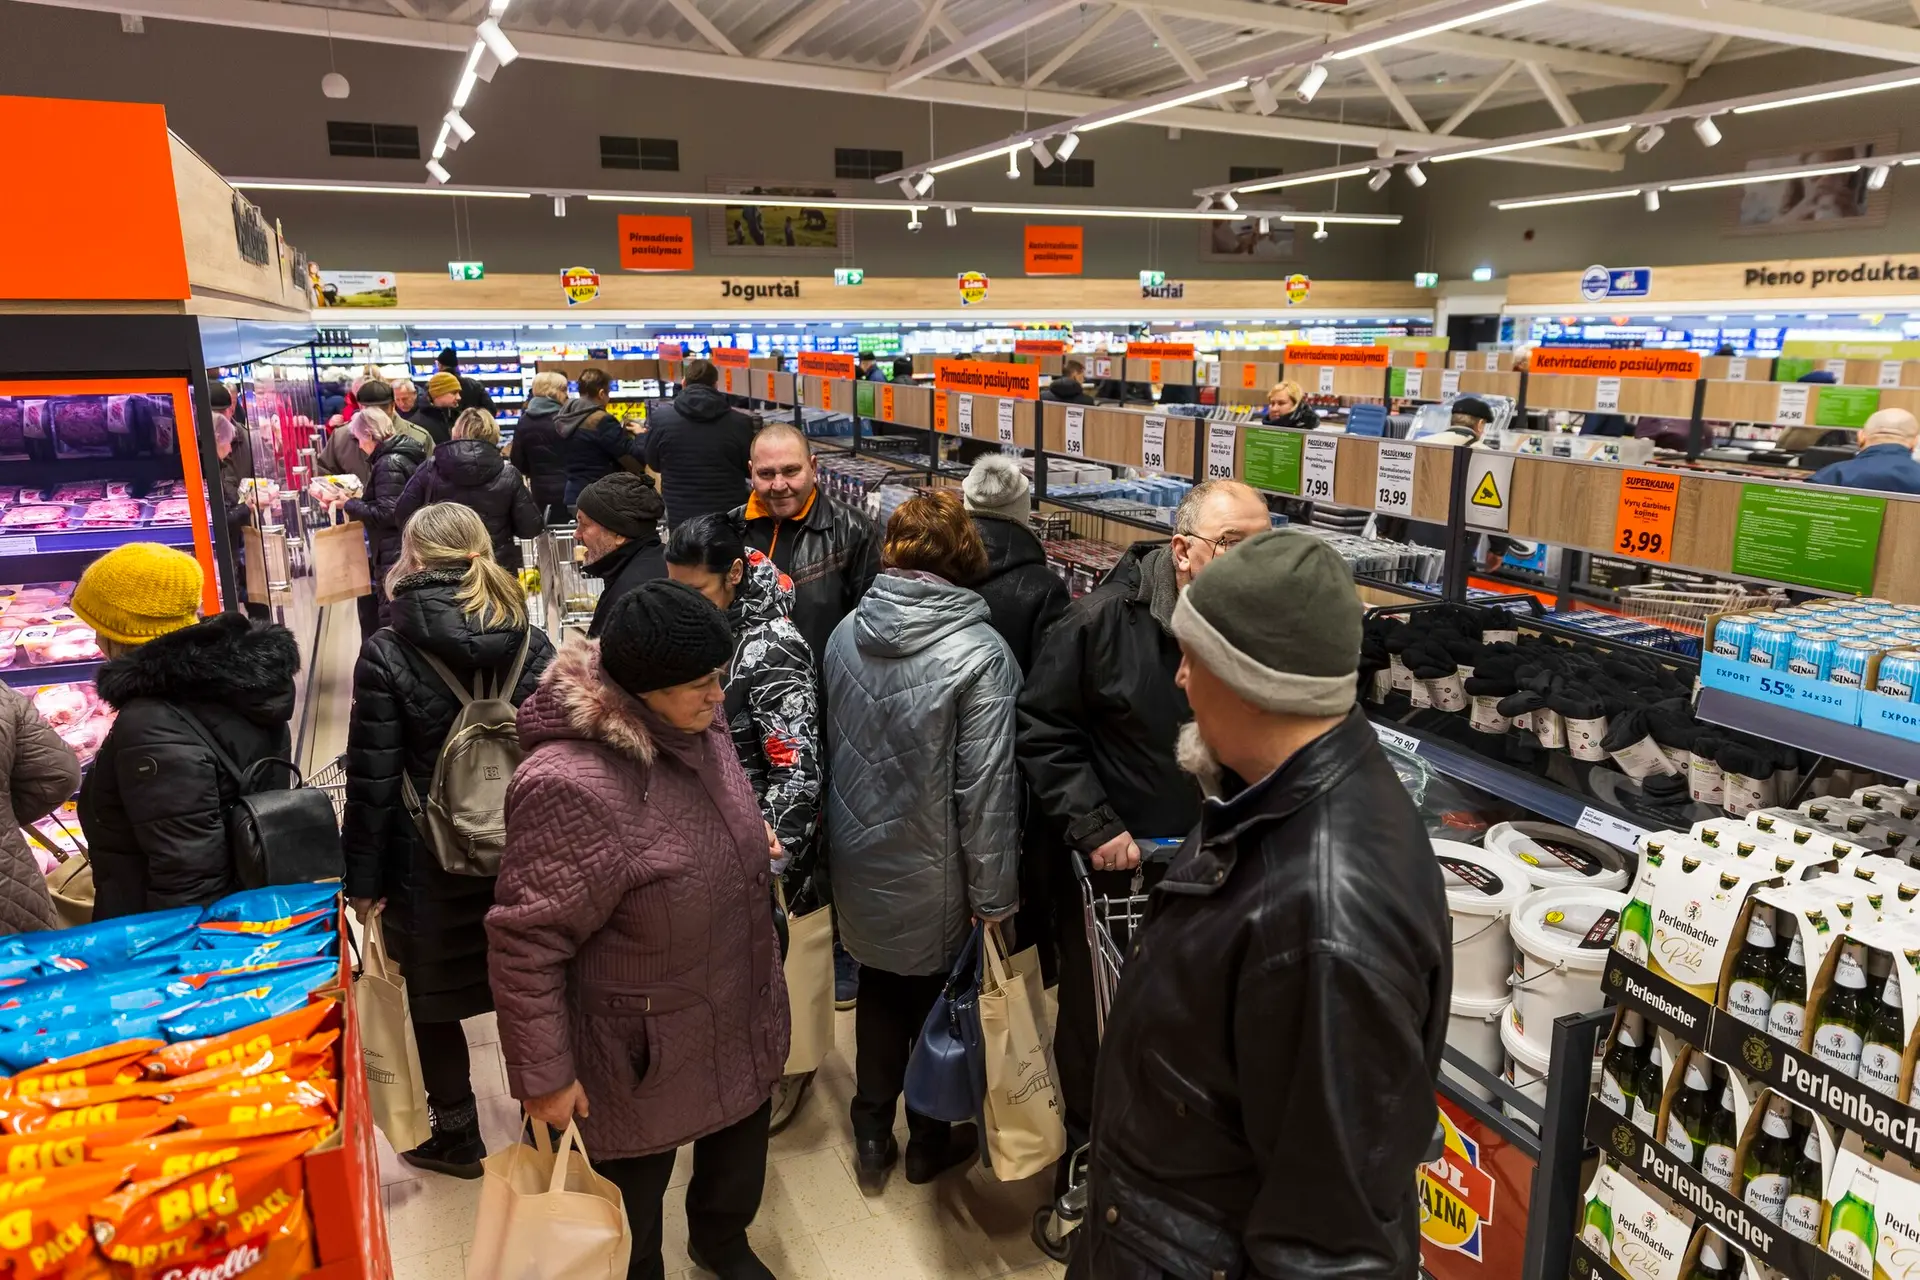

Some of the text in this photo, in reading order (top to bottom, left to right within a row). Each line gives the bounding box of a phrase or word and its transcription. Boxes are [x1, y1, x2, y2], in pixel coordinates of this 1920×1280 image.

[629, 232, 684, 243] Pirmadienio
[1745, 266, 1805, 287] Pieno
[721, 280, 800, 301] Jogurtai
[1288, 350, 1385, 364] Ketvirtadienio pasiūlymas
[1536, 354, 1693, 374] Ketvirtadienio pasiūlymas
[940, 366, 1030, 392] Pirmadienio pasiūlymas
[1000, 430, 1011, 441] 2,99
[1067, 440, 1080, 454] 5,99
[1144, 452, 1161, 466] 9,99
[1210, 464, 1231, 478] 29,90
[1306, 478, 1328, 496] 7,99
[1625, 477, 1674, 490] SUPERKAINA
[1379, 488, 1407, 506] 13,99
[1624, 498, 1670, 511] Vyrų darbinės
[1634, 508, 1658, 518] kojinės
[1620, 528, 1662, 554] 3,99
[1716, 668, 1750, 683] EXPORT
[1802, 690, 1812, 698] 24
[1820, 694, 1832, 704] 33
[1834, 697, 1842, 706] cl
[1882, 710, 1920, 726] EXPOR
[1658, 909, 1719, 948] Perlenbacher
[1660, 936, 1703, 968] Pils
[1626, 976, 1697, 1029] Perlenbacher
[205, 1034, 272, 1068] BIG
[1782, 1053, 1920, 1154] Perlenbach
[7, 1136, 86, 1175] BIG
[158, 1172, 239, 1233] BIG
[237, 1188, 294, 1233] PACK
[1642, 1142, 1774, 1254] Perlenbacher
[29, 1222, 88, 1271] PACK
[1618, 1214, 1674, 1262] Perlenbacher
[111, 1236, 188, 1268] PARTY
[1622, 1242, 1660, 1276] Pils
[1830, 1246, 1870, 1276] Perlenbacher
